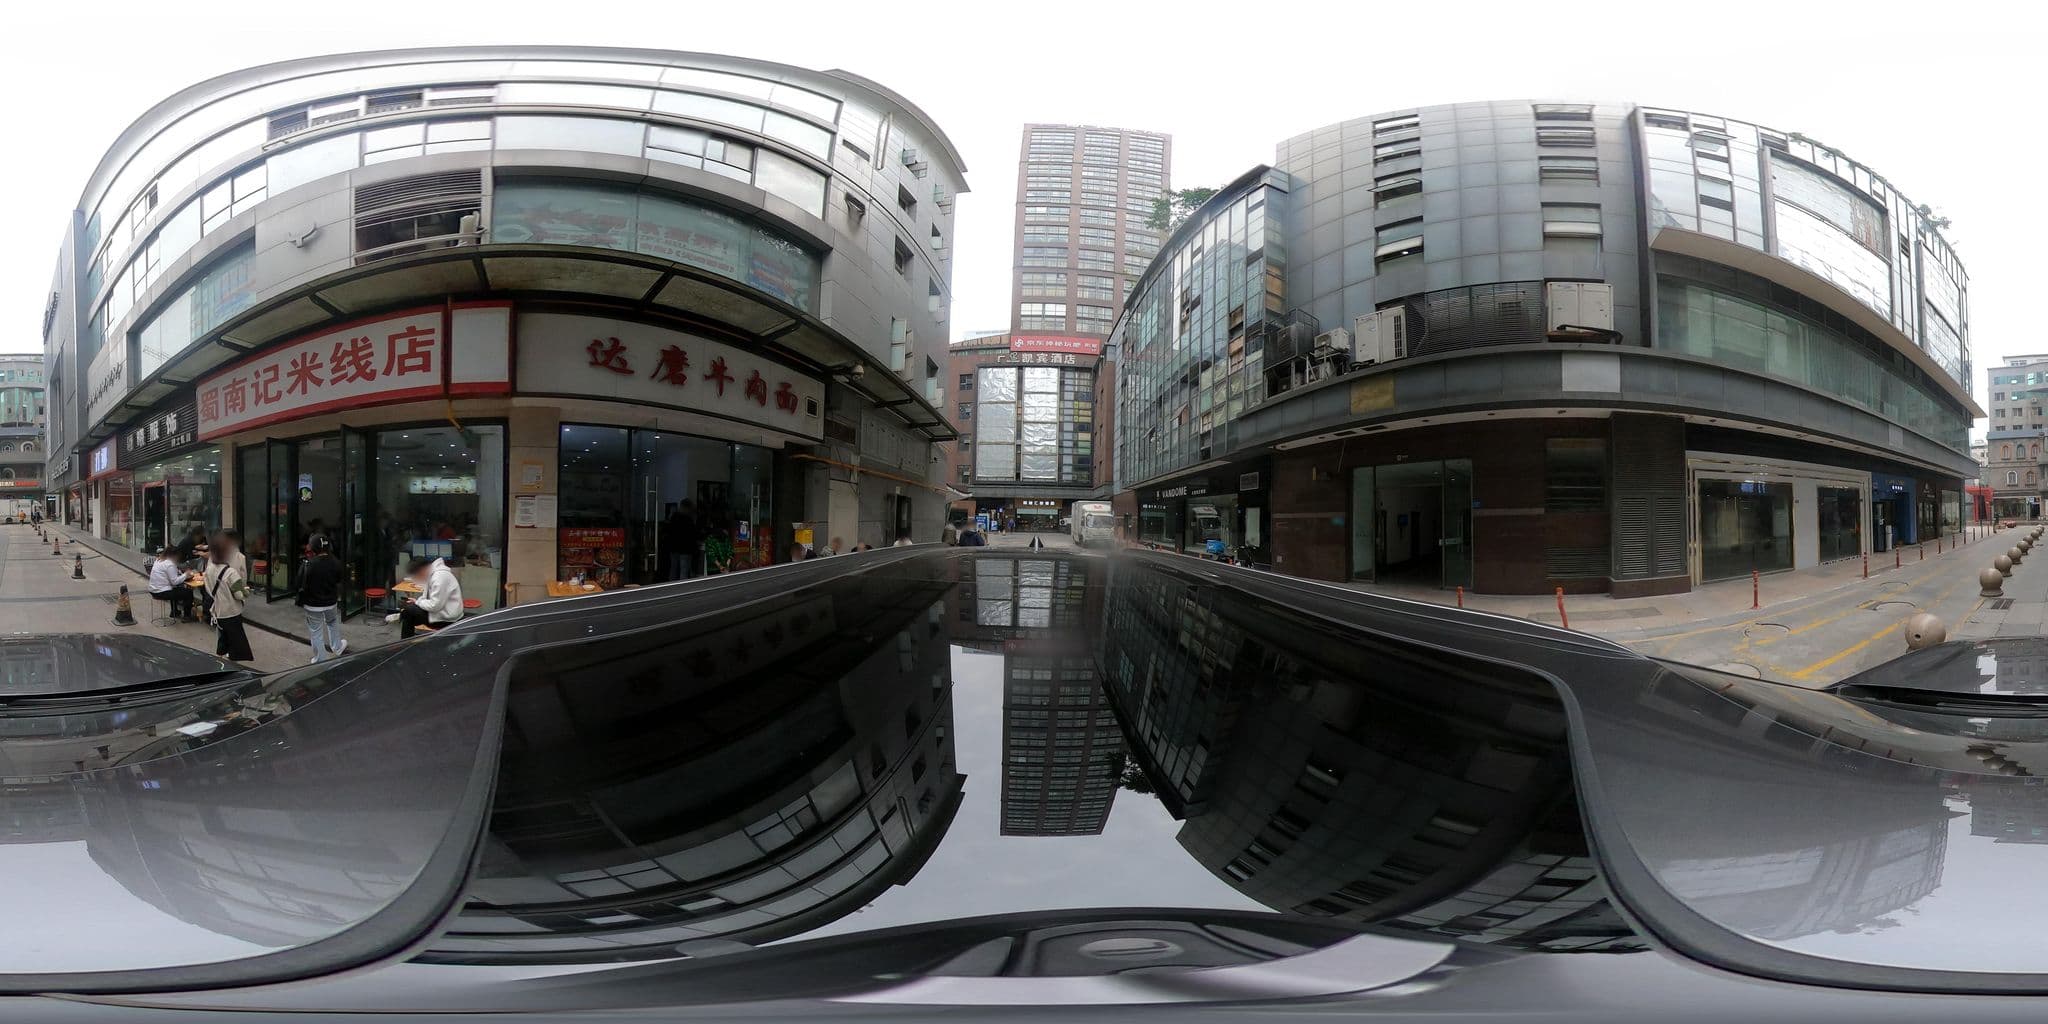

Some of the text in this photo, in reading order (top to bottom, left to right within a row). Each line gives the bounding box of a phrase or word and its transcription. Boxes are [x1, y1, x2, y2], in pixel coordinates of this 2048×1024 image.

[199, 325, 436, 423] 蜀南记米线店
[585, 337, 800, 415] 达磨牛肉面
